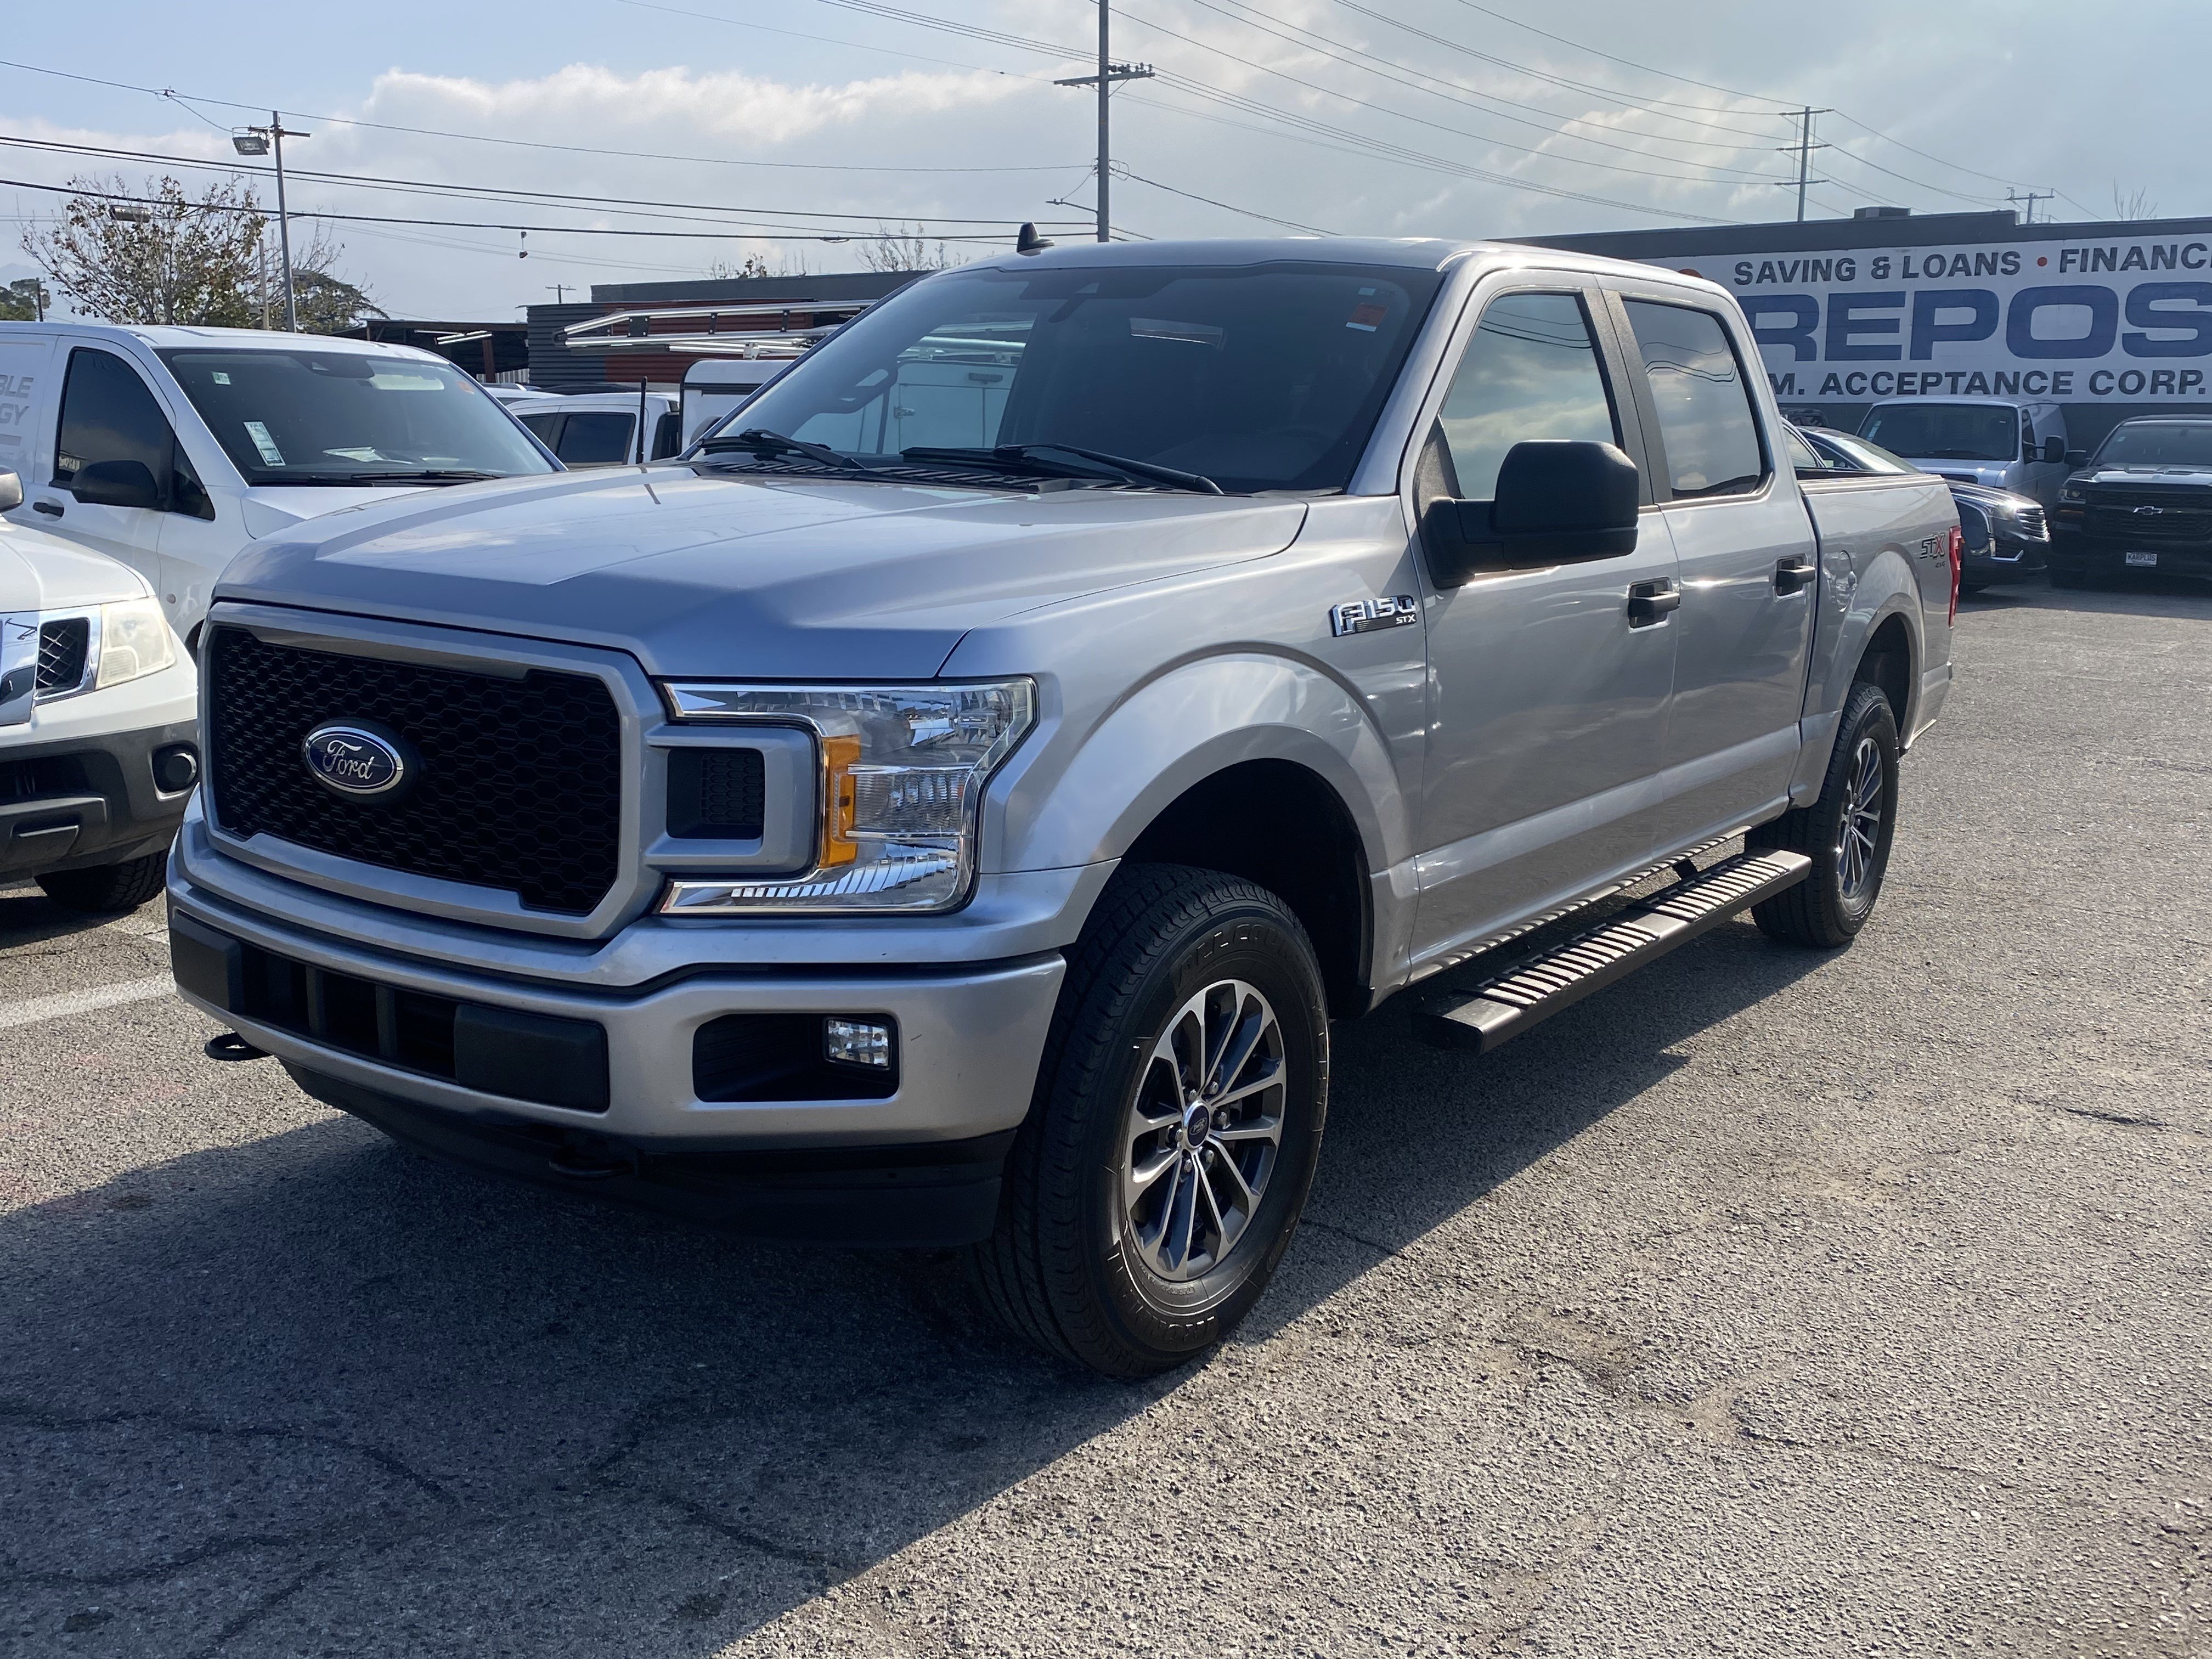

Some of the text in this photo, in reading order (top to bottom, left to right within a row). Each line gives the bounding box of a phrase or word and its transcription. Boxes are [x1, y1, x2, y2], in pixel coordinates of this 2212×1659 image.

[1734, 242, 2212, 285] SAVING & LOANS FINANC
[1737, 281, 2212, 362] REPOS
[1819, 370, 2074, 396] ACCEPTANCE
[2089, 370, 2207, 396] CORP.
[1920, 532, 1945, 560] STX
[1396, 613, 1417, 624] STX
[322, 740, 374, 780] Ford
